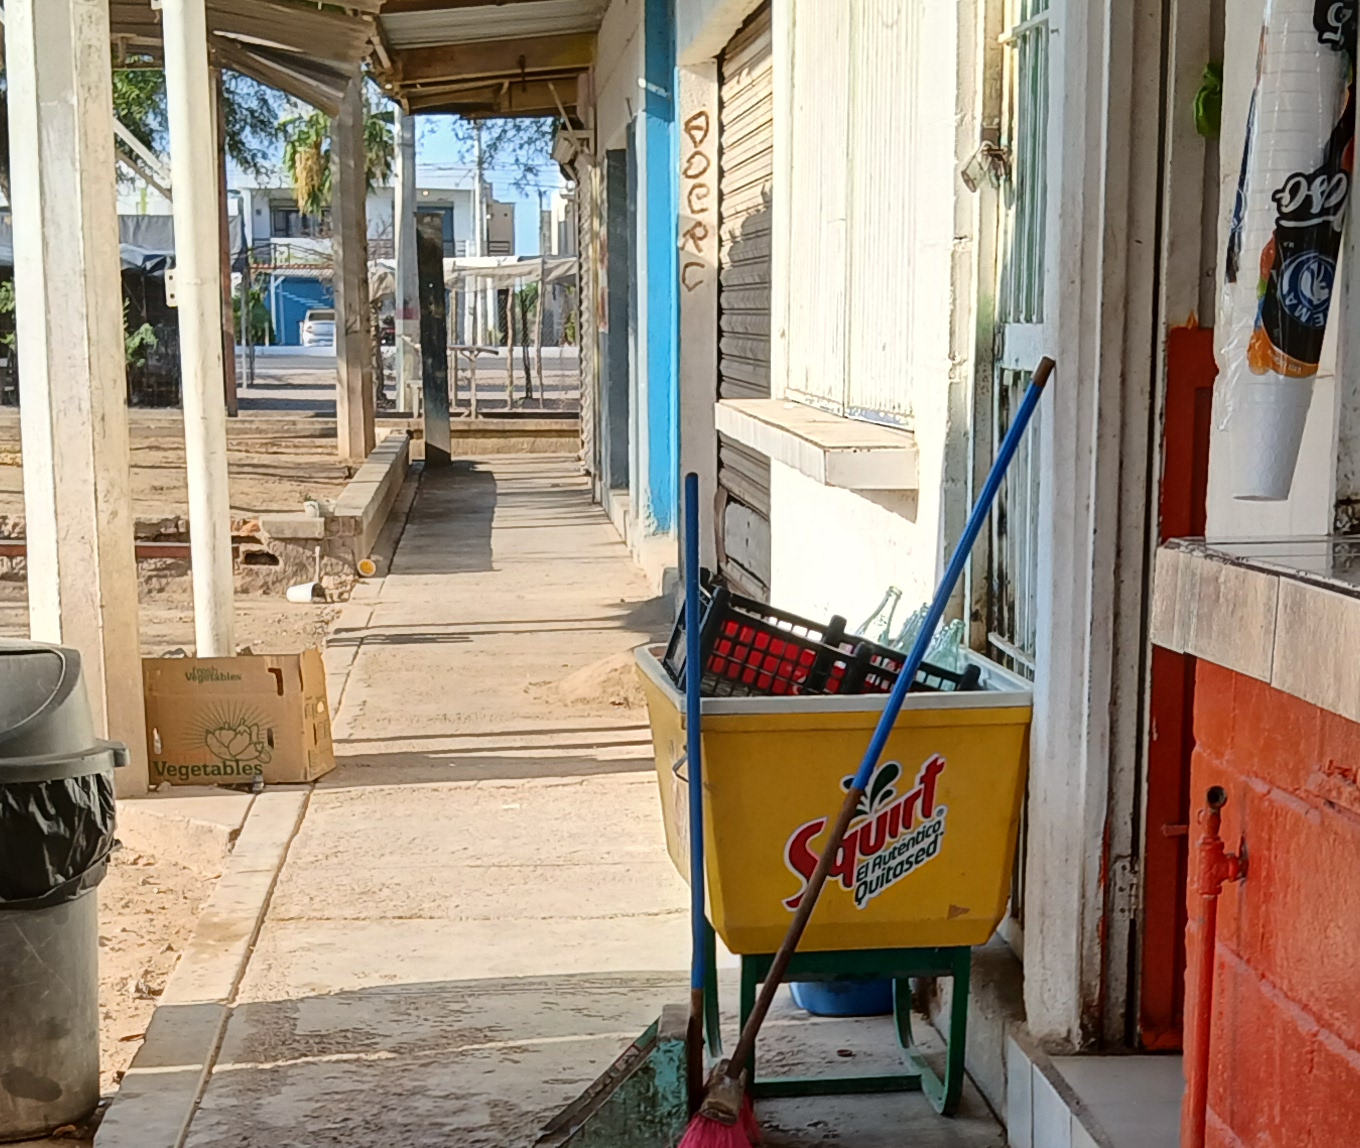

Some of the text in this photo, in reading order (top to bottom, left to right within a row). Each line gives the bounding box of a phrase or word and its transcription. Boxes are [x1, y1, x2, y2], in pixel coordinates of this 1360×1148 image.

[185, 672, 242, 684] Vegetables
[152, 760, 263, 780] Vegetables
[785, 756, 946, 909] Squirt
[854, 833, 941, 906] Quitased
